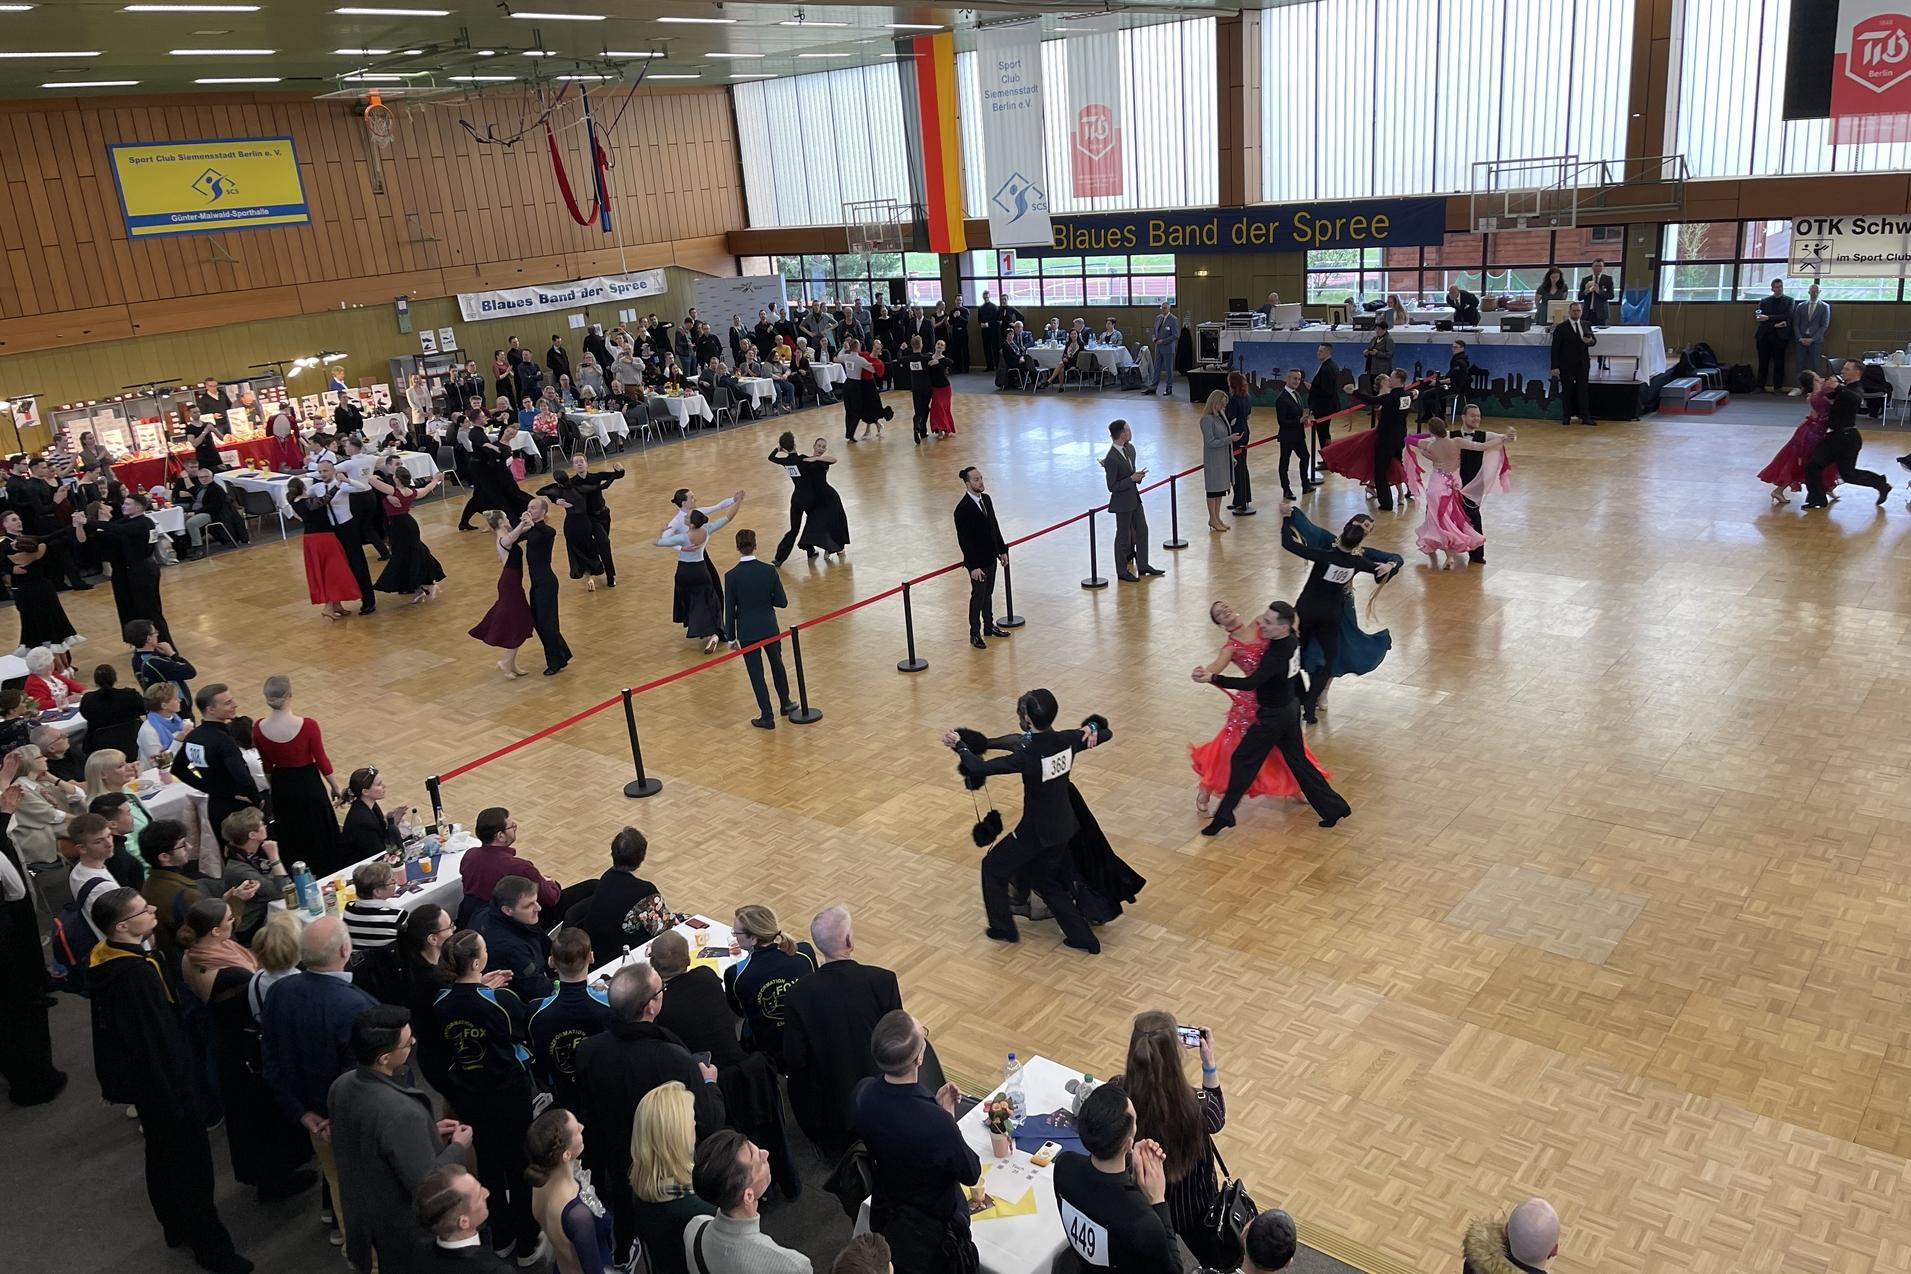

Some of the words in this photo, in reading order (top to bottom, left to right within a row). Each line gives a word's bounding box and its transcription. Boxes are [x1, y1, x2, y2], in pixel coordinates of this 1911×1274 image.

[998, 59, 1022, 71] Sport
[1001, 74, 1020, 84] Club
[1868, 70, 1893, 78] Berlin
[984, 84, 1039, 99] Siemensstadt
[992, 102, 1017, 112] Berlin
[1018, 99, 1033, 110] e.V.
[128, 156, 153, 164] Sport
[177, 152, 236, 161] Siemensstadt
[238, 150, 262, 158] Berlin
[1031, 202, 1047, 211] SCS
[171, 208, 269, 222] Günter-Maiwald-Sporthalle
[1052, 223, 1137, 250] Blaues
[1149, 218, 1218, 247] Band
[1231, 217, 1279, 245] der
[1292, 211, 1390, 248] Spree
[1796, 218, 1843, 236] OTK
[1851, 218, 1911, 235] Schw
[1003, 254, 1011, 271] 1
[1853, 253, 1883, 263] Sport
[1886, 253, 1911, 261] Club
[481, 299, 534, 312] Blaues
[539, 290, 576, 304] Band
[581, 286, 603, 298] der
[609, 281, 648, 295] Spree
[463, 1028, 487, 1038] FOX
[1070, 1216, 1096, 1258] 449
